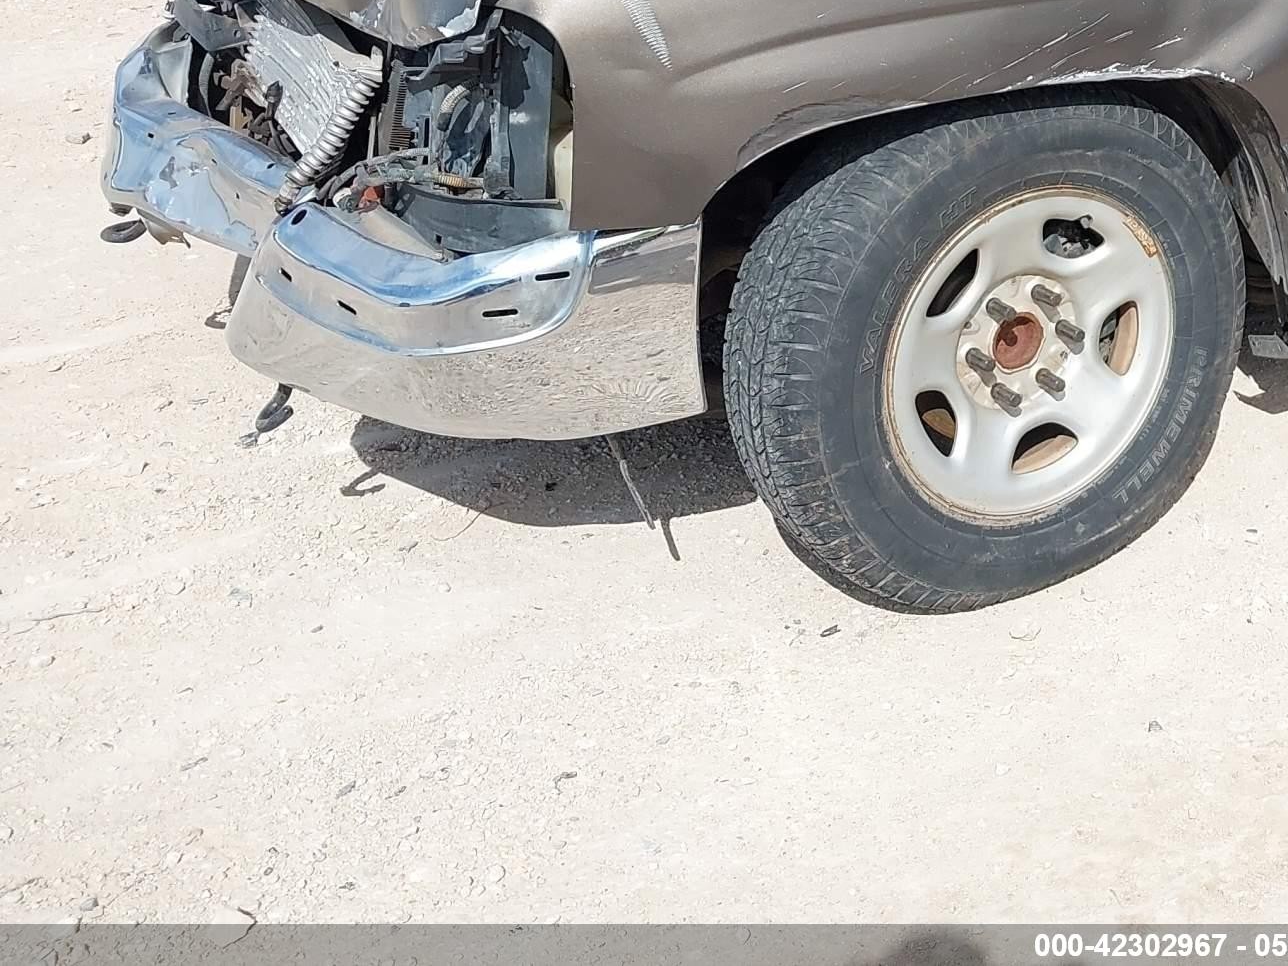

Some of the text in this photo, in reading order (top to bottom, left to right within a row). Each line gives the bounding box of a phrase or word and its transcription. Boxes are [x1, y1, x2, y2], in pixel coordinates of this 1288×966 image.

[859, 186, 977, 375] VALERA HT
[1111, 345, 1209, 505] PRIMEWELL
